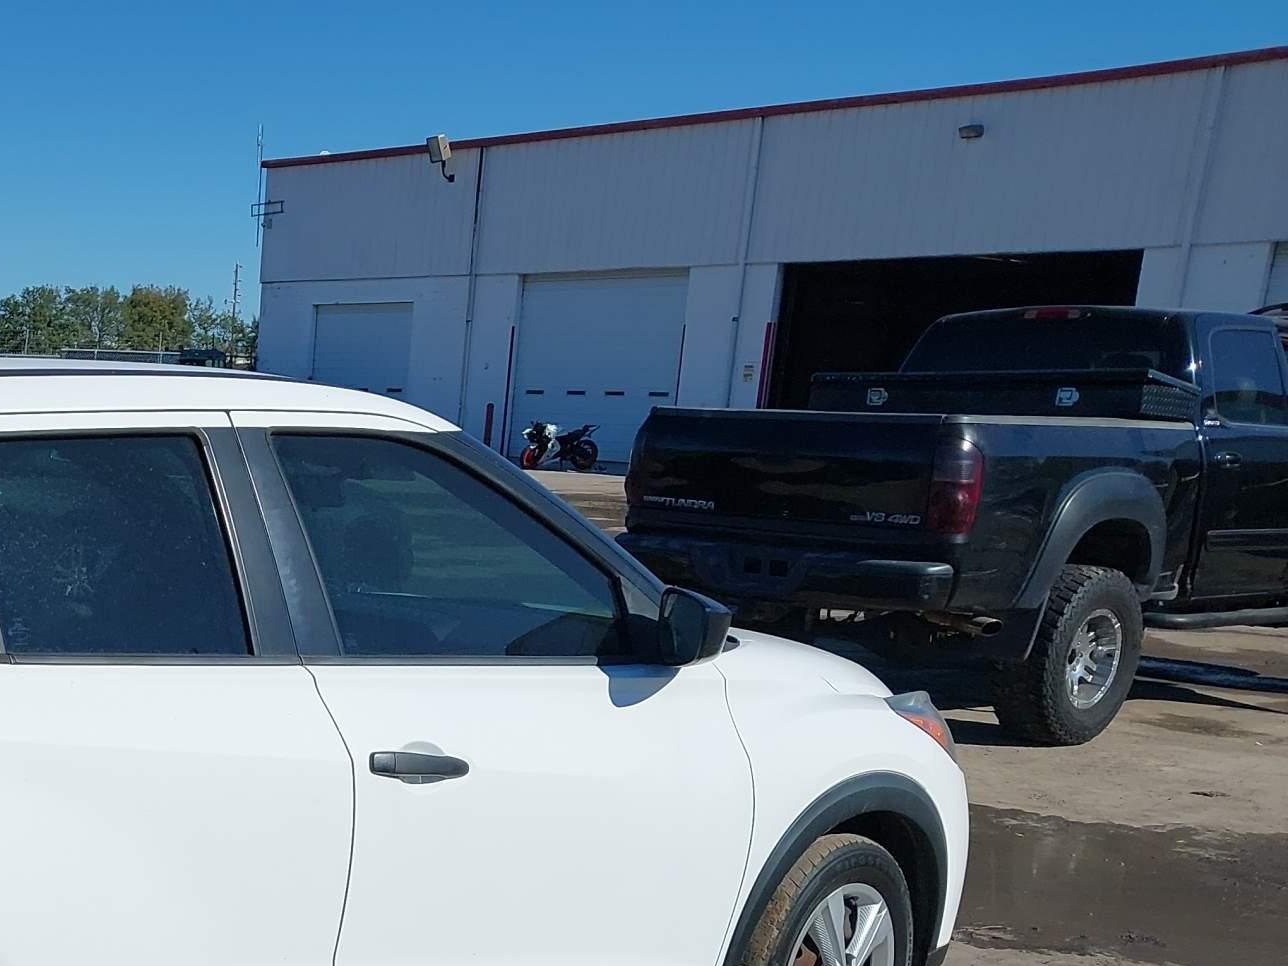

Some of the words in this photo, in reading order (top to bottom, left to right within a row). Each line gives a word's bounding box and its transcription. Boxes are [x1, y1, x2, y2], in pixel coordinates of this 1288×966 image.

[663, 496, 715, 511] TUNDRA
[866, 511, 886, 522] V8
[887, 513, 922, 525] 4WD
